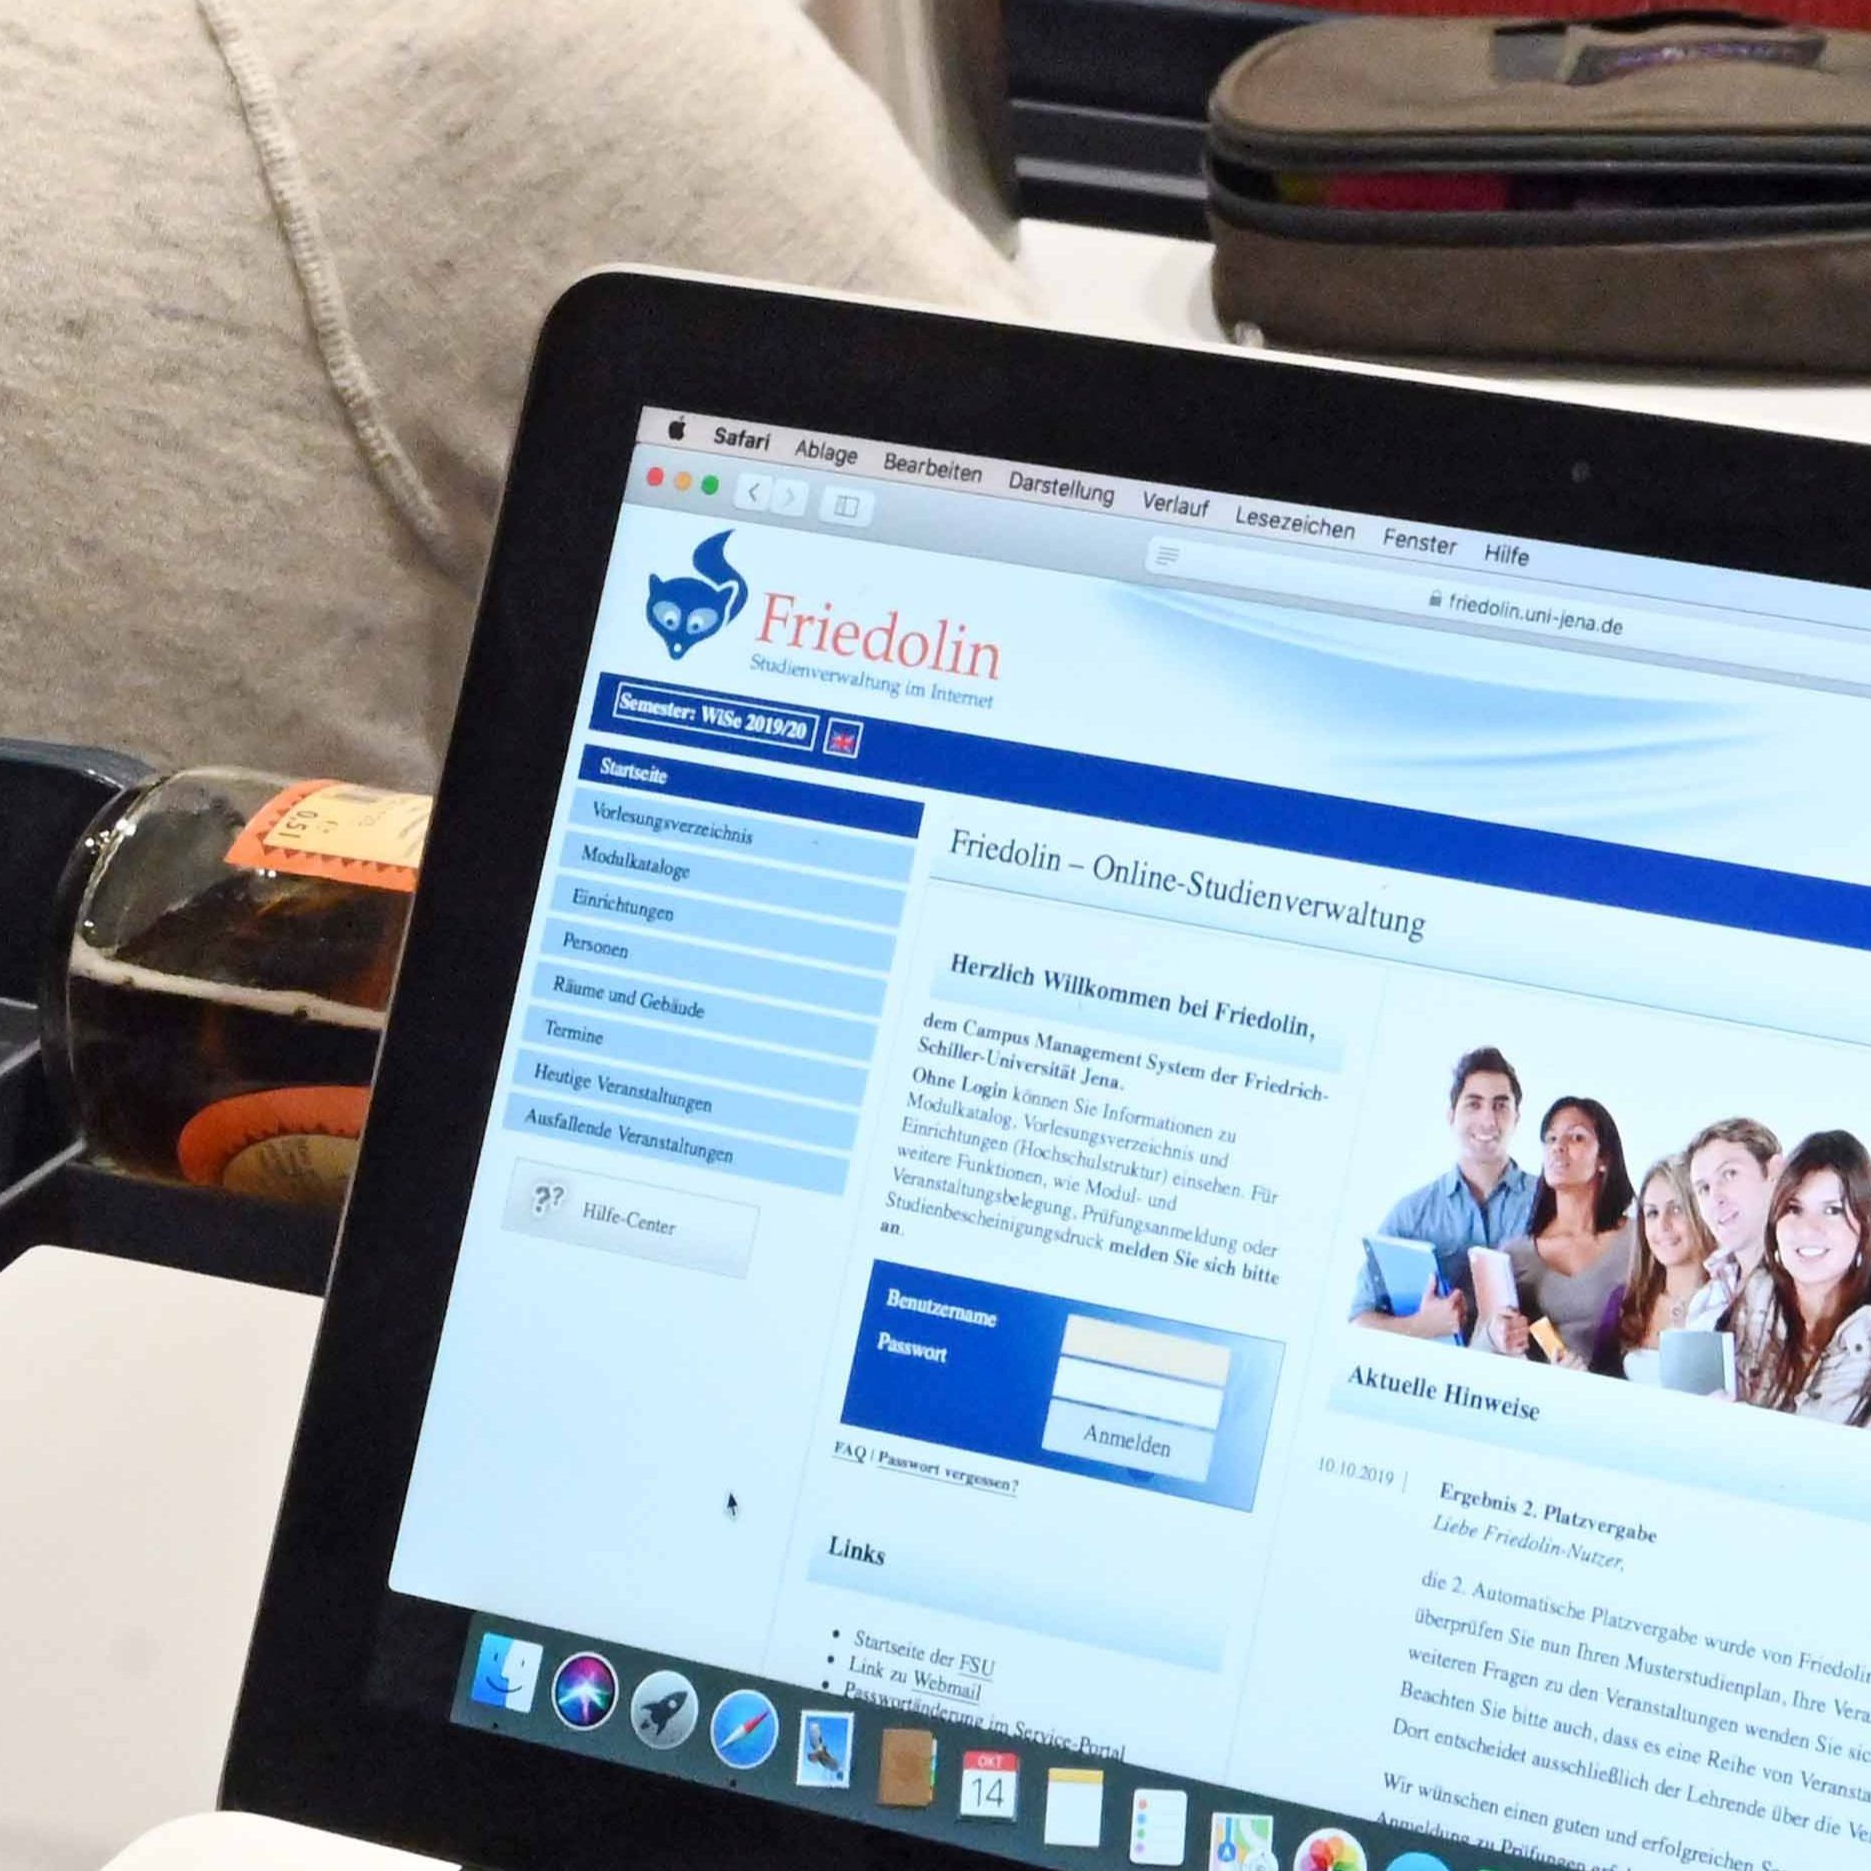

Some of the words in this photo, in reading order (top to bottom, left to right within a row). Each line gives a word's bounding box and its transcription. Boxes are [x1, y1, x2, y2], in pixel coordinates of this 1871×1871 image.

[713, 426, 772, 452] Safari
[794, 438, 859, 468] Ablage
[883, 451, 983, 484] Bearbeiten
[1008, 470, 1116, 509] Darstellung
[1143, 490, 1211, 518] Verlauf
[1235, 505, 1356, 540] Lesezeichen
[1383, 527, 1459, 556] Fenster
[1484, 543, 1530, 567] Hilfe
[755, 592, 999, 681] Friedolin
[1449, 593, 1624, 636] friedolin.uni-jena.de
[749, 652, 902, 699] Studienverwaltung
[905, 680, 926, 698] im
[930, 682, 995, 710] Internet
[619, 692, 696, 721] Semester:
[701, 705, 742, 729] WiSe
[744, 713, 808, 740] 2019/20
[599, 756, 669, 785] Startseite
[593, 800, 754, 845] Vorlesungsverzeichnis
[581, 844, 691, 883] Modulkataloge
[950, 828, 1061, 872] Friedolin
[1092, 854, 1427, 944] Online-Studienverwaltung
[571, 887, 675, 923] Einrichtungen
[562, 930, 629, 960] Personen
[552, 974, 606, 1000] Räume
[608, 989, 638, 1006] und
[639, 991, 706, 1019] Gebäude
[951, 953, 1035, 987] Herzlich
[1044, 969, 1171, 1012] Willkommen
[1178, 994, 1209, 1019] bei
[1214, 1001, 1315, 1042] Friedolin,
[545, 1018, 604, 1046] Termine
[917, 1036, 1077, 1082] Schiller-Universität
[922, 1011, 958, 1033] dem
[962, 1018, 1030, 1047] Campus
[1035, 1031, 1142, 1068] Management
[1145, 1053, 1206, 1080] System
[1210, 1066, 1239, 1086] der
[1244, 1071, 1329, 1102] Friedrich-
[533, 1062, 592, 1092] Heutige
[597, 1074, 713, 1115] Veranstaltungen
[911, 1066, 956, 1090] Ohne
[961, 1075, 1008, 1101] Login
[1012, 1085, 1069, 1112] können
[1073, 1097, 1098, 1117] Sie
[1102, 1102, 1213, 1139] Informationen
[1217, 1130, 1237, 1144] zu
[524, 1107, 613, 1139] Ausfallende
[618, 1124, 734, 1165] Veranstaltungen
[901, 1115, 1009, 1153] Einrichtungen
[1012, 1138, 1169, 1185] (Hochschulstruktur)
[1250, 1184, 1279, 1205] Für
[1024, 1112, 1194, 1162] Vorlesungsverzeichnis
[1199, 1152, 1230, 1169] und
[897, 1145, 953, 1167] weitere
[1053, 1176, 1081, 1193] wie
[1084, 1177, 1142, 1204] Modul-
[1147, 1194, 1178, 1212] und
[582, 1201, 677, 1236] Hilfe-Center
[885, 1190, 1104, 1250] Studienbescheinigungsdruck
[1108, 1240, 1169, 1263] melden
[1173, 1248, 1200, 1270] Sie
[1202, 1256, 1236, 1277] sich
[1241, 1262, 1280, 1286] bitte
[1081, 1203, 1238, 1254] Prüfungsanmeldung
[1242, 1239, 1280, 1258] oder
[886, 1287, 998, 1328] Benutzername
[876, 1331, 948, 1364] Passwort
[1348, 1365, 1437, 1400] Aktuelle
[1444, 1383, 1540, 1422] Hinweise
[1082, 1423, 1171, 1458] Anmelden
[834, 1440, 867, 1463] FAQ
[878, 1449, 940, 1476] Passwort
[945, 1468, 1019, 1493] vergessen?
[1433, 1513, 1479, 1538] Liebe
[1439, 1481, 1517, 1514] Ergebnis
[1522, 1499, 1537, 1519] 2.
[1543, 1503, 1658, 1544] Platzvergabe
[828, 1535, 886, 1566] Links
[1421, 1570, 1447, 1591] die
[1471, 1581, 1586, 1621] Automatische
[1590, 1606, 1699, 1646] Platzvergabe
[1704, 1636, 1757, 1659] wurde
[1761, 1648, 1793, 1667] von
[853, 1629, 926, 1662] Startseite
[929, 1647, 955, 1668] der
[958, 1653, 996, 1677] FSU
[1414, 1607, 1504, 1642] überprüfen
[1507, 1627, 1536, 1649] Sie
[1540, 1639, 1571, 1657] nun
[1576, 1641, 1620, 1668] Ihren
[1791, 1689, 1827, 1714] Ihre
[848, 1655, 885, 1679] Link
[889, 1669, 908, 1684] zu
[914, 1669, 982, 1702] Webmail
[977, 1753, 1002, 1770] OKT
[972, 1777, 1005, 1808] 14
